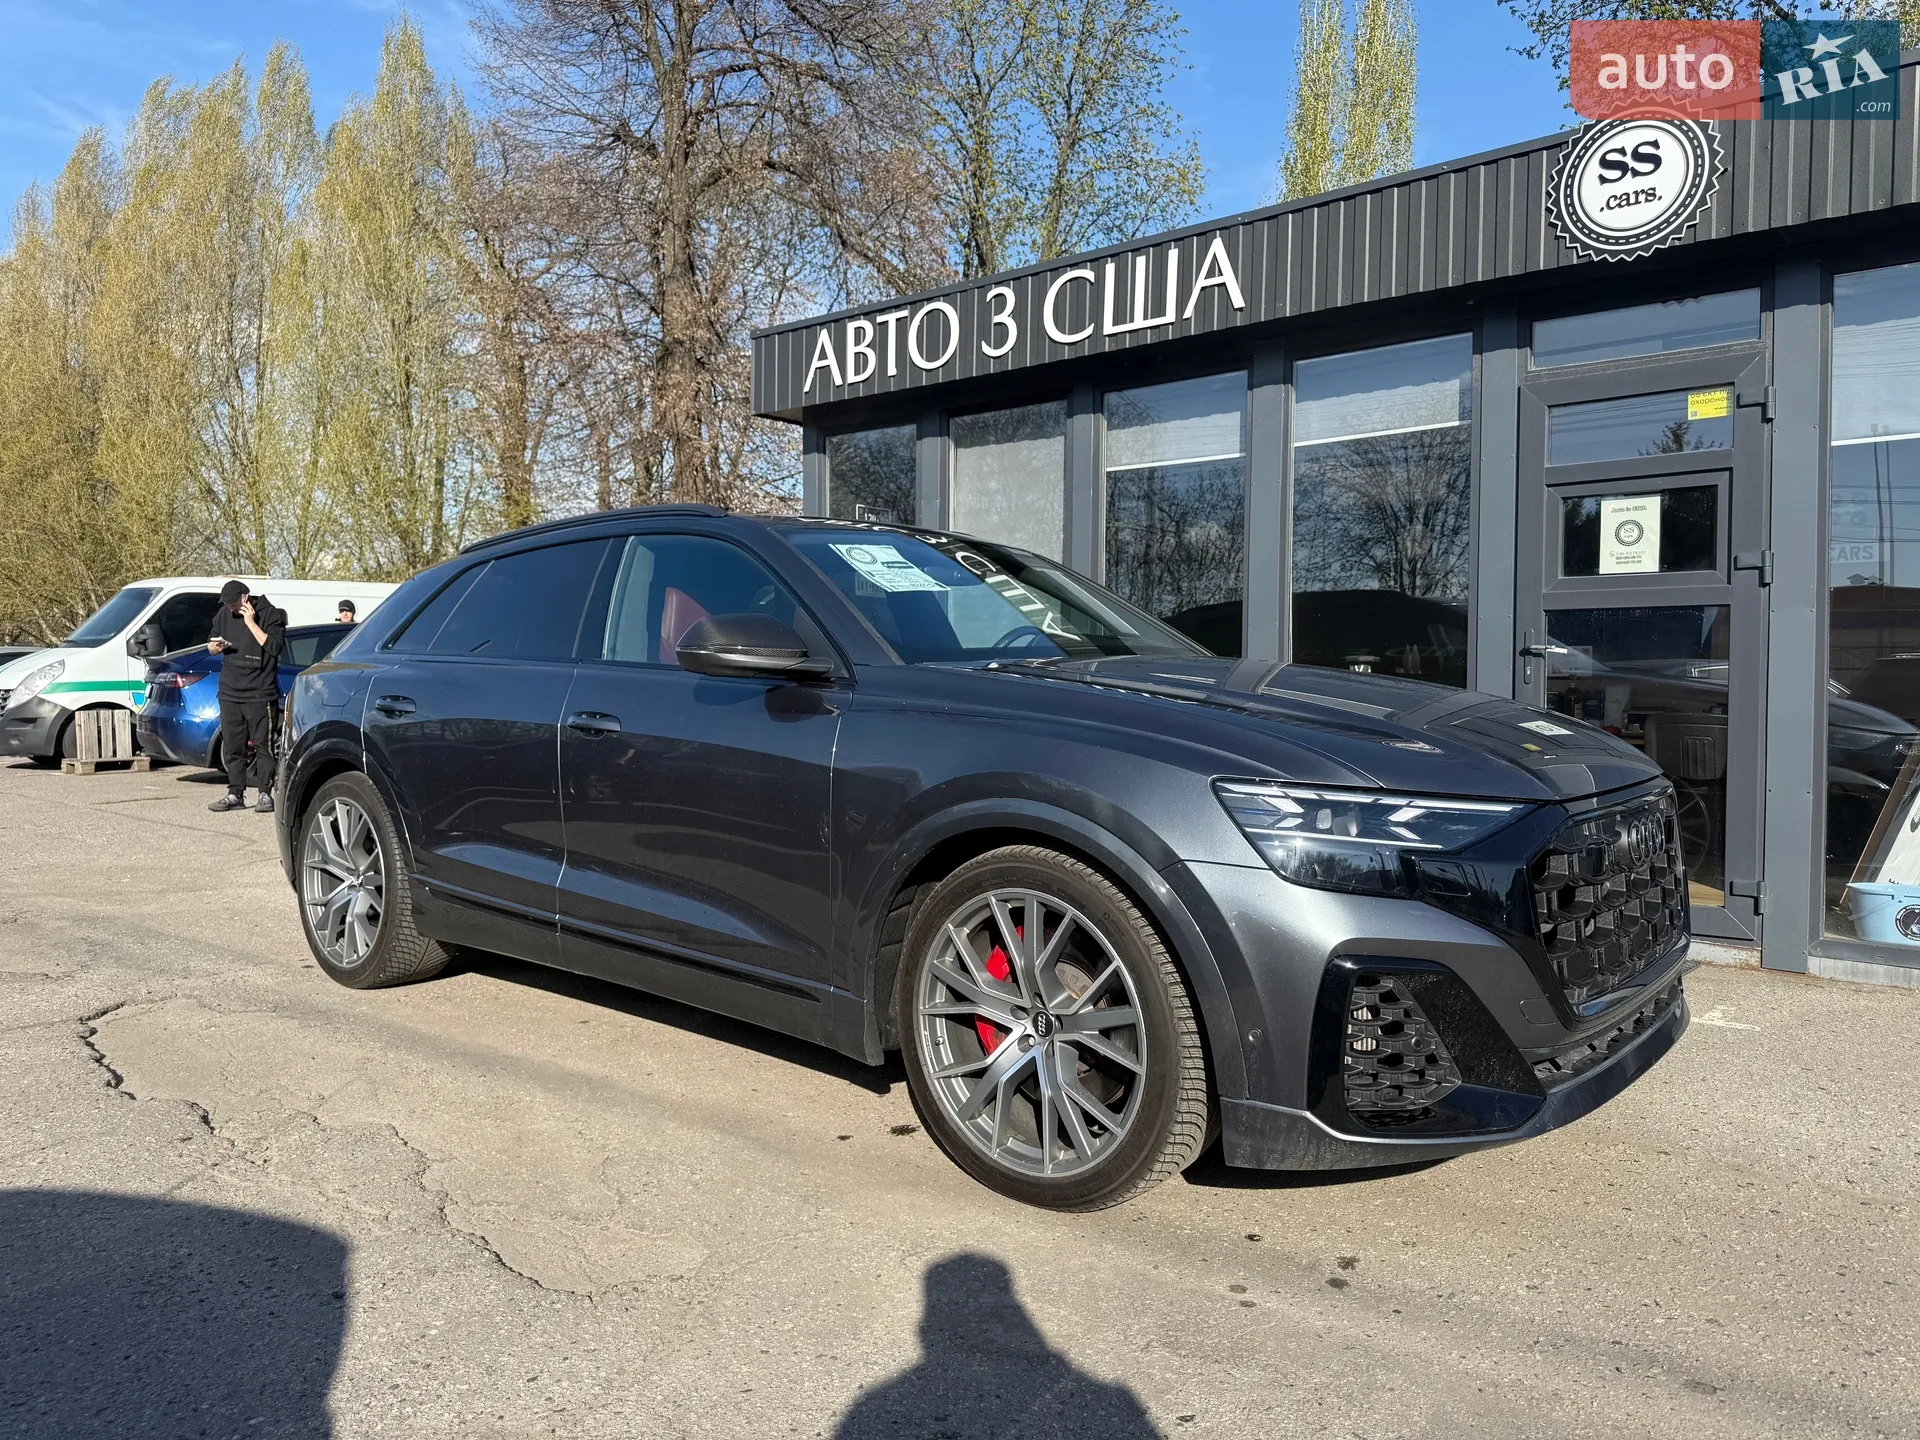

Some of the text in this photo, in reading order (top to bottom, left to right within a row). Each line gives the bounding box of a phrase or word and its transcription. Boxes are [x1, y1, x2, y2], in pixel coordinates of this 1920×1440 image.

[1598, 139, 1663, 186] SS
[803, 236, 1246, 393] АВТО З США
[1690, 395, 1733, 405] охороною
